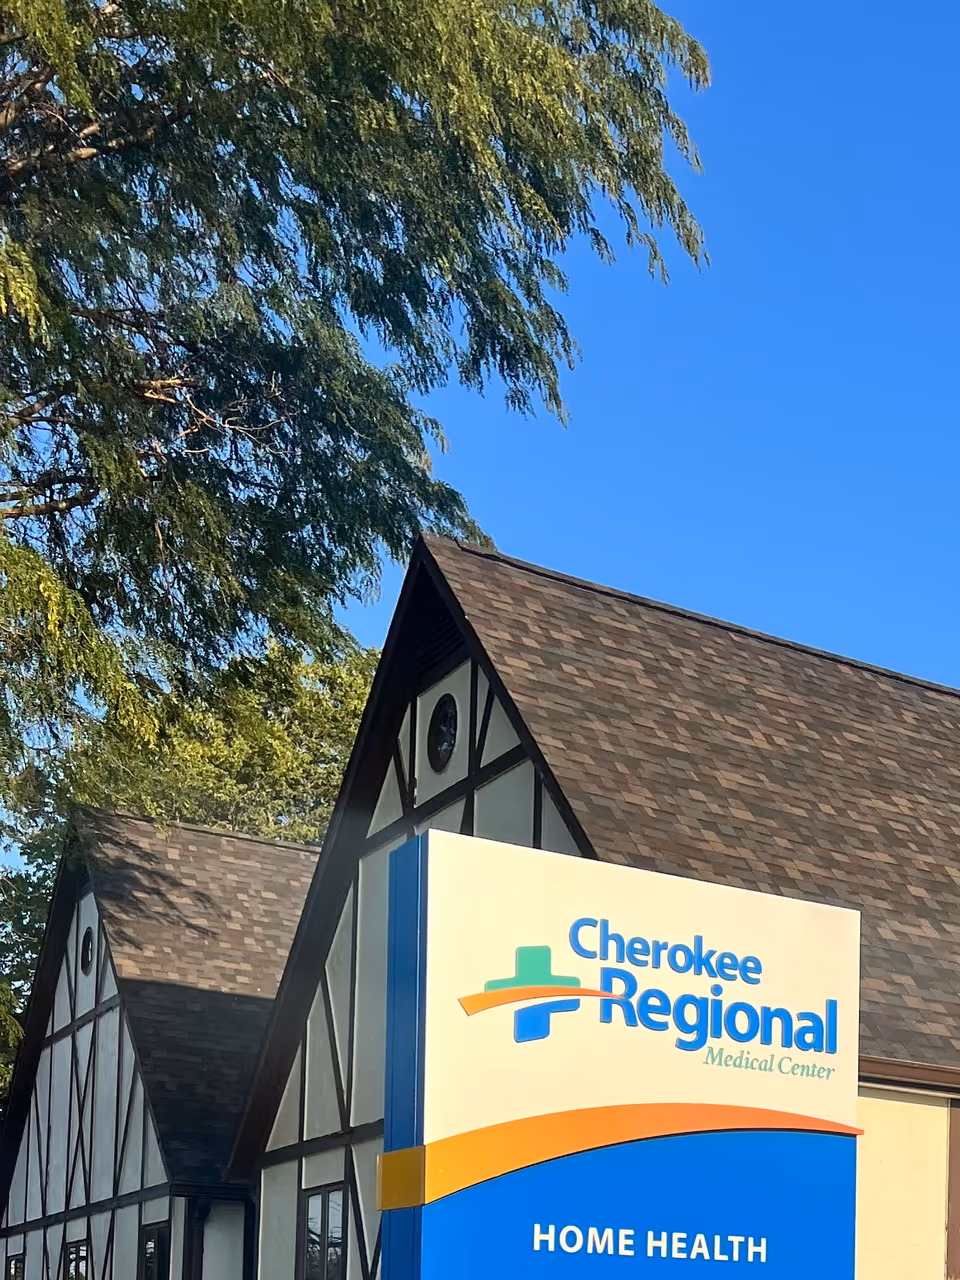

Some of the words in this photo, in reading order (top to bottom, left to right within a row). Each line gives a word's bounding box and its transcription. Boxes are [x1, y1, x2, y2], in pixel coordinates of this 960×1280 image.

[569, 917, 763, 985] Cherokee
[599, 966, 838, 1055] Regional
[703, 1046, 775, 1073] Medical
[777, 1055, 836, 1080] Center
[533, 1223, 635, 1257] HOME
[646, 1230, 768, 1263] HEALTH
